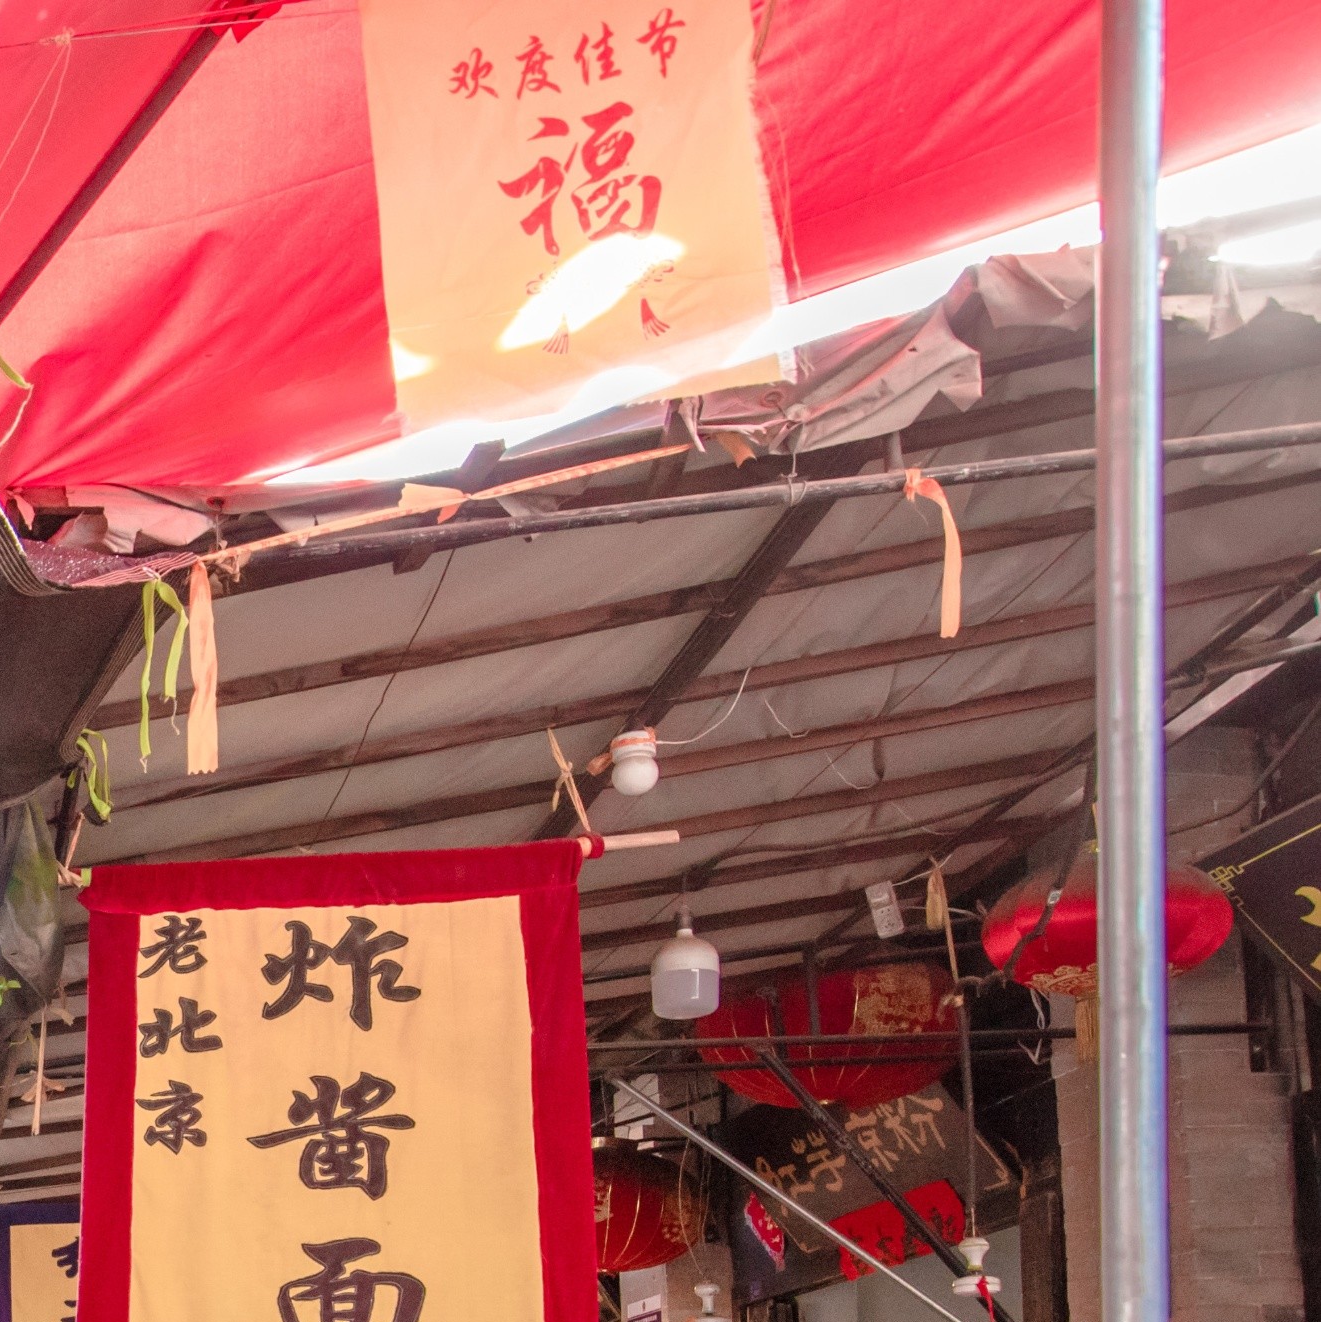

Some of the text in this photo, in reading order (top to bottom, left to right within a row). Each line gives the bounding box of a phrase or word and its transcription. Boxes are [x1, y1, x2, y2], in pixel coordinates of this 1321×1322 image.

[448, 8, 686, 100] 欢度佳节
[497, 100, 662, 256] 福
[135, 914, 224, 1155] 老北京
